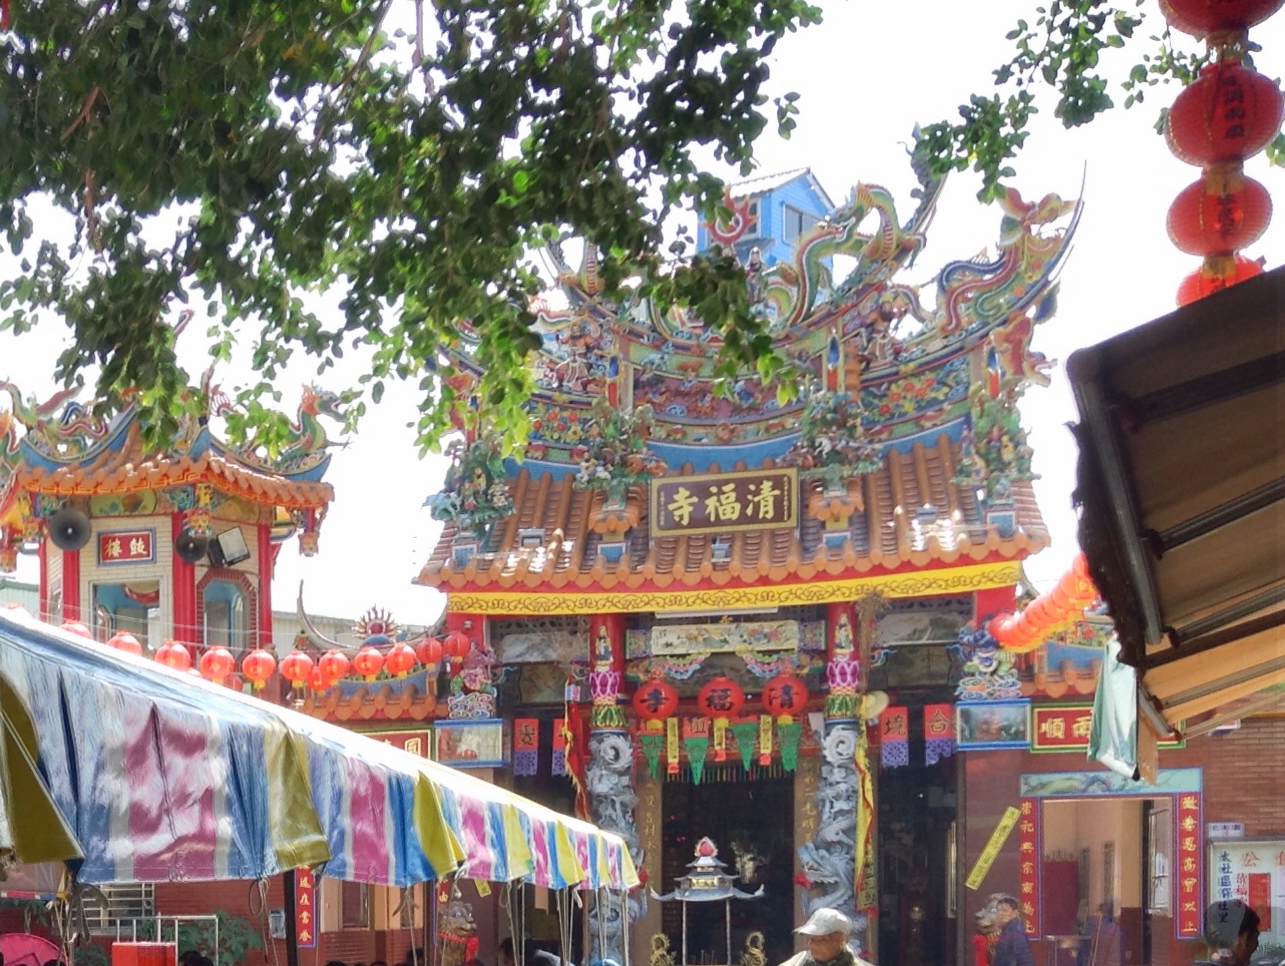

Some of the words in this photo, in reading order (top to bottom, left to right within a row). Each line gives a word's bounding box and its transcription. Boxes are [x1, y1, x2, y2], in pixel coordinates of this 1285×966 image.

[667, 479, 782, 526] 清福寺
[104, 537, 148, 558] 鼓樓
